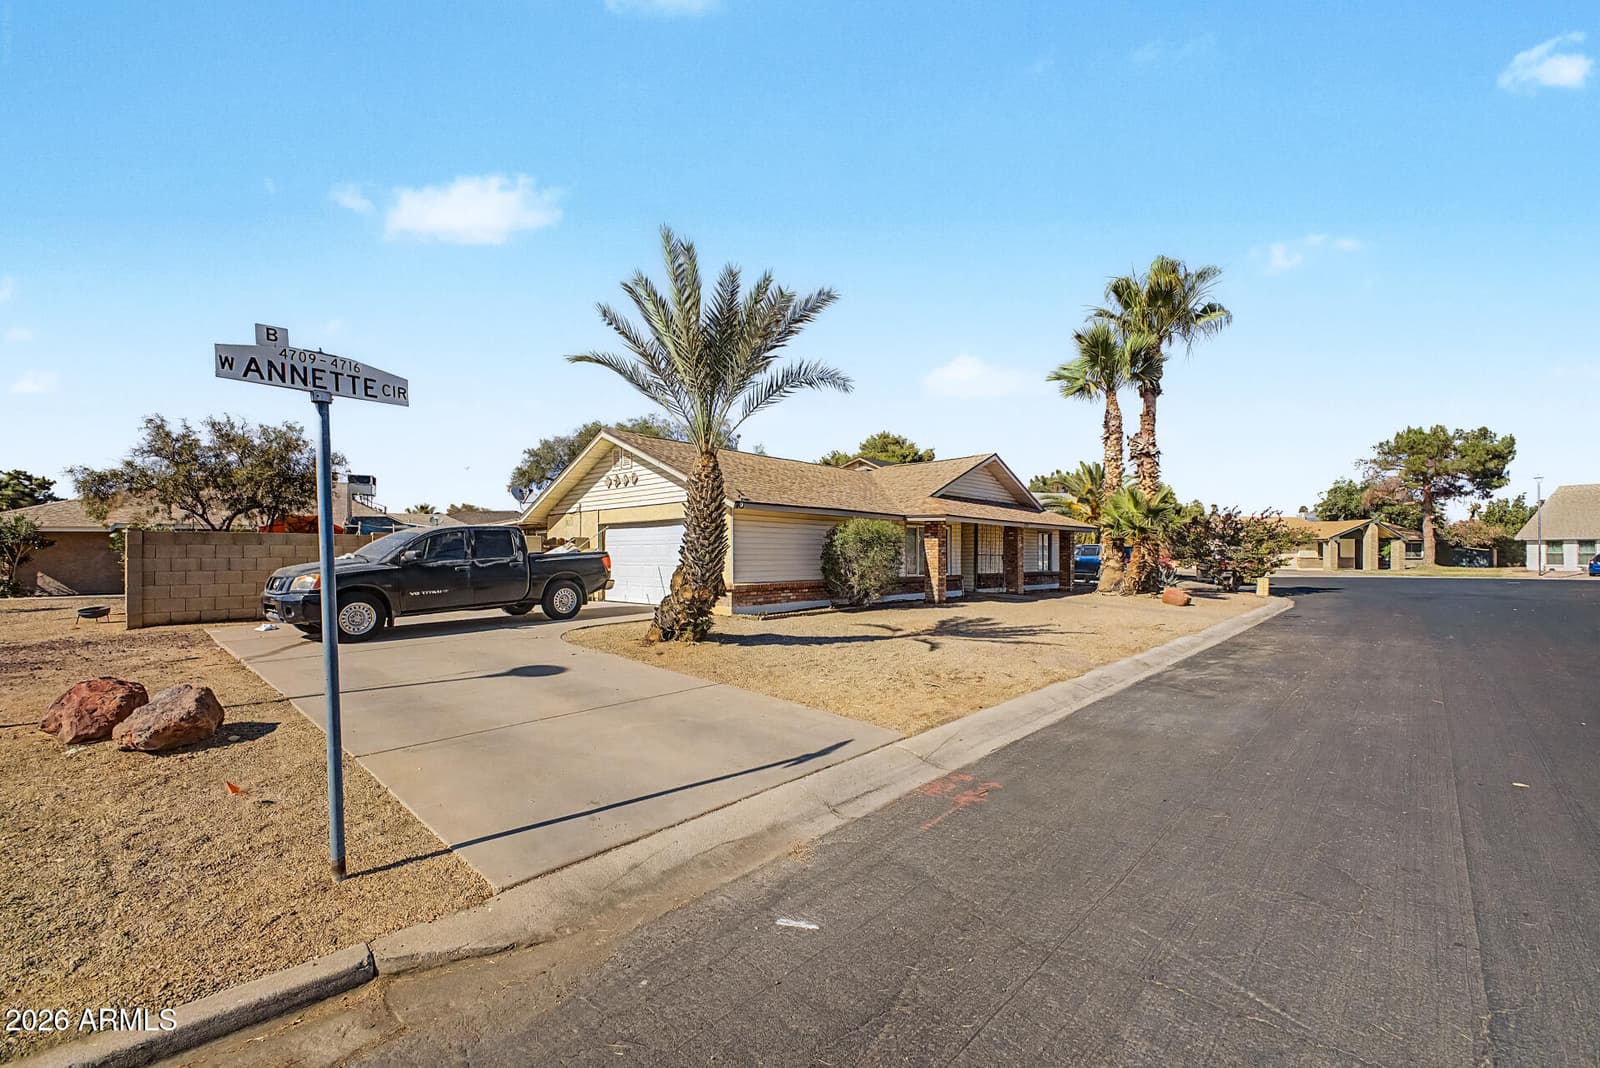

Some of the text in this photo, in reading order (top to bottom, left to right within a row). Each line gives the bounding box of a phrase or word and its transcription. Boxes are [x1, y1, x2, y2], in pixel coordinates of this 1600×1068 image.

[266, 328, 278, 342] B
[218, 354, 407, 401] W ANNETTE CIR
